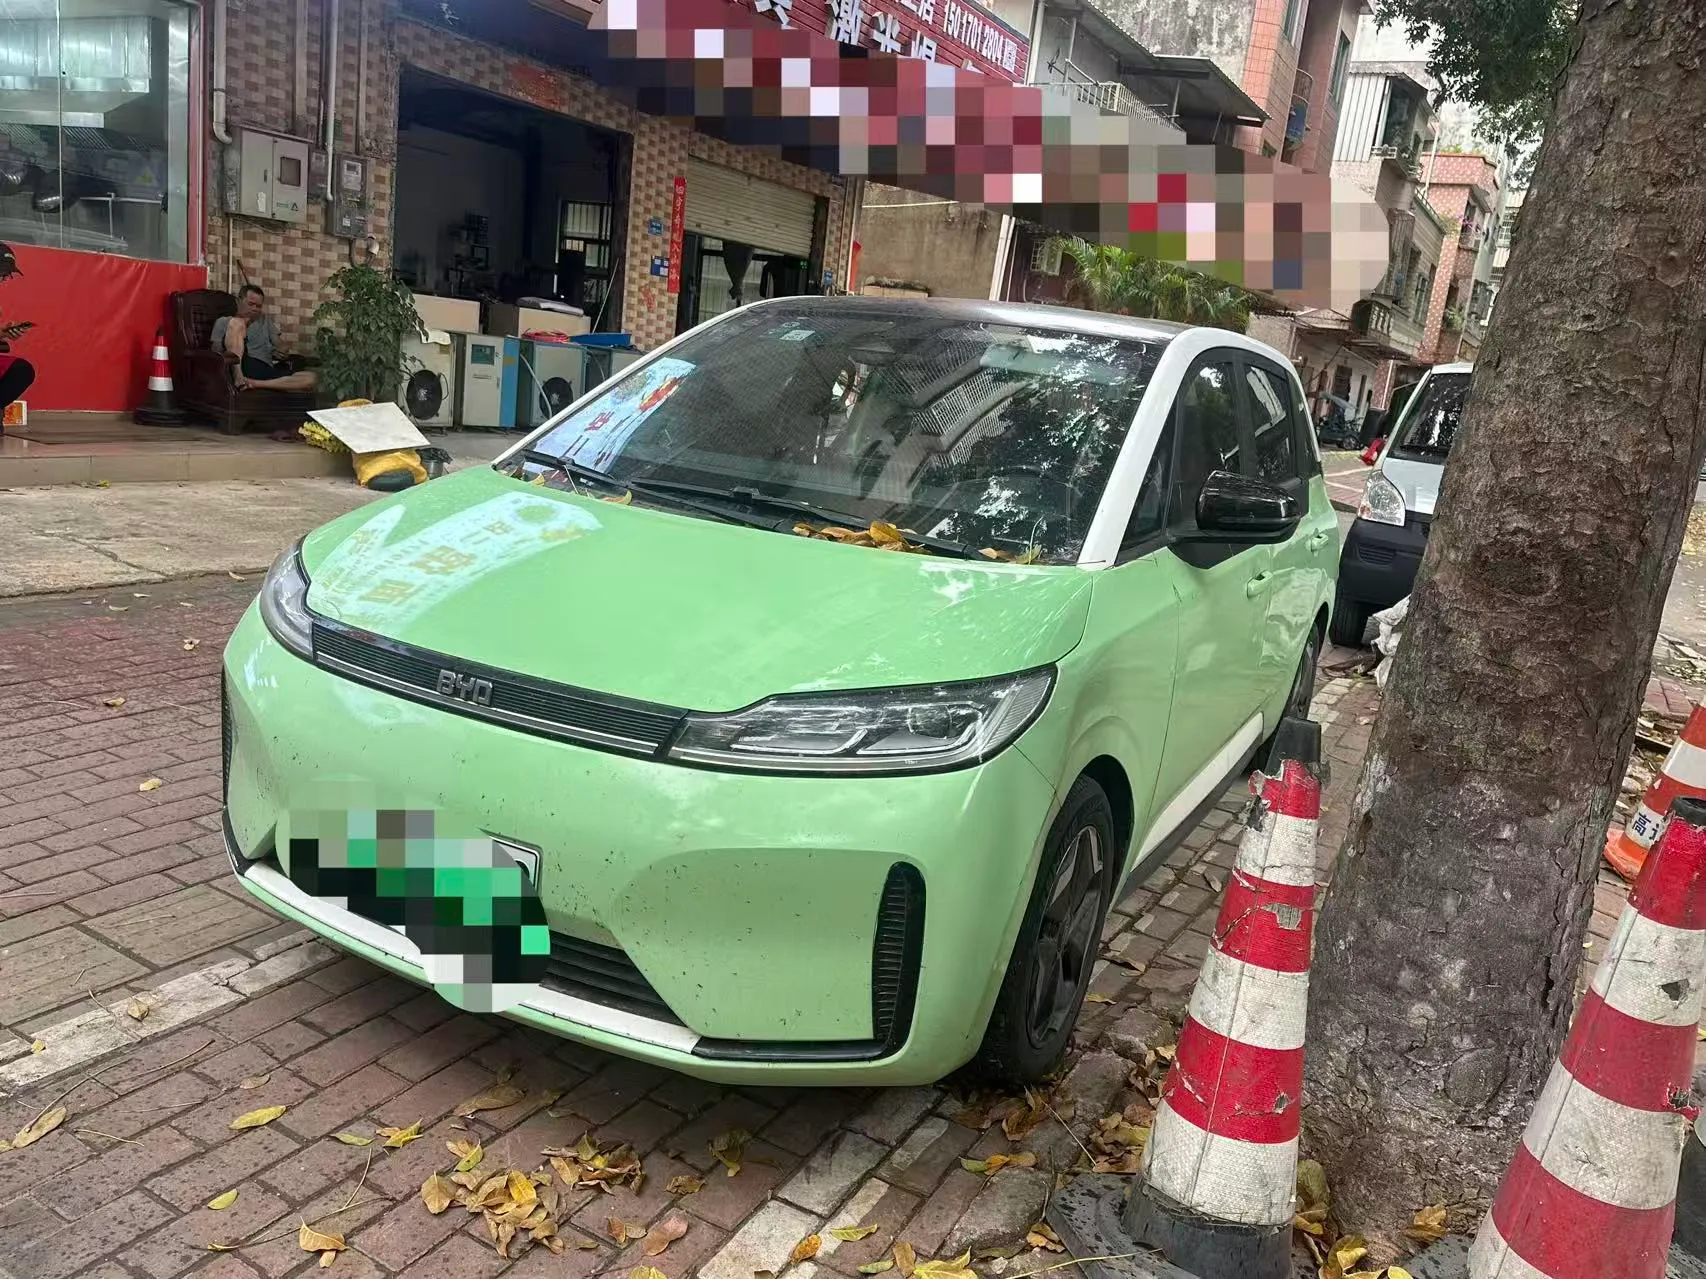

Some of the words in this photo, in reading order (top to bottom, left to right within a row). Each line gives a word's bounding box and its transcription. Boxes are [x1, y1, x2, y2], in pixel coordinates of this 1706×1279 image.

[961, 10, 983, 53] 1701
[982, 24, 1004, 66] 2804
[436, 669, 493, 706] BYD
[1631, 812, 1661, 840] 高
